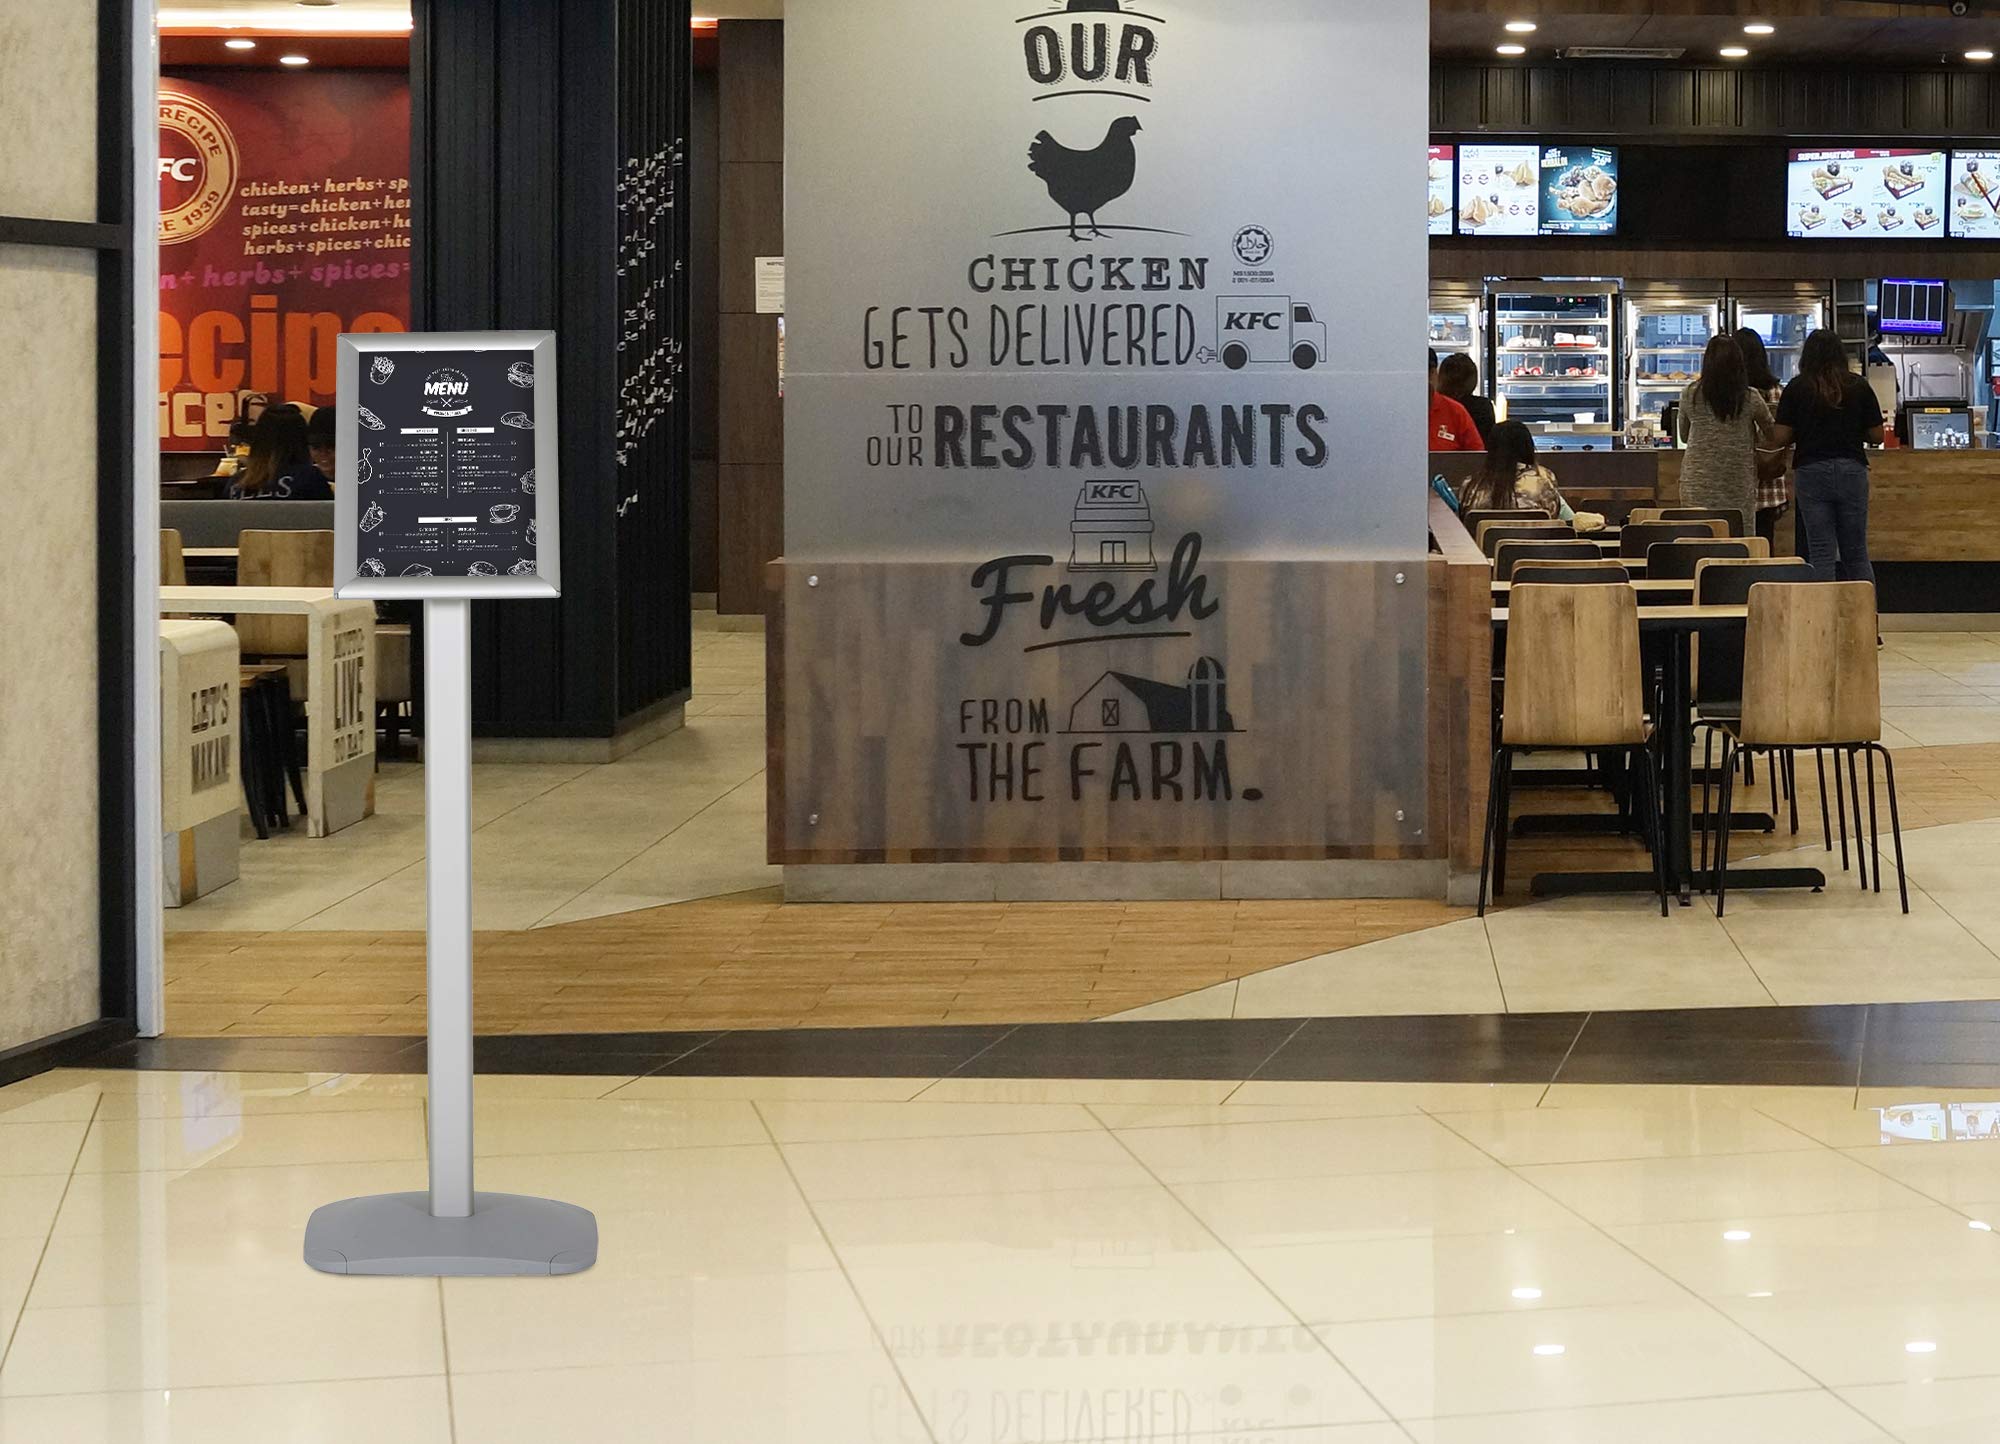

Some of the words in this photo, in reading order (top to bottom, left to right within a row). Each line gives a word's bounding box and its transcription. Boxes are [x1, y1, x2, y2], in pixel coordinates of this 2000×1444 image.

[1024, 23, 1159, 87] OUR
[160, 107, 222, 158] RECIPE
[182, 190, 220, 226] 1939
[968, 254, 1209, 293] CHICKEN
[864, 306, 969, 369] GETS
[990, 303, 1195, 367] DELIVERED
[1224, 312, 1284, 330] KFC
[424, 381, 469, 395] MENU
[886, 404, 923, 433] TO
[934, 403, 1329, 469] RESTAURANTS
[867, 436, 923, 466] OUR
[1090, 485, 1135, 498] KFC
[959, 531, 1219, 646] Fresh
[959, 698, 1050, 734] FROM
[956, 741, 1046, 802] THE
[1070, 739, 1263, 802] FARM.
